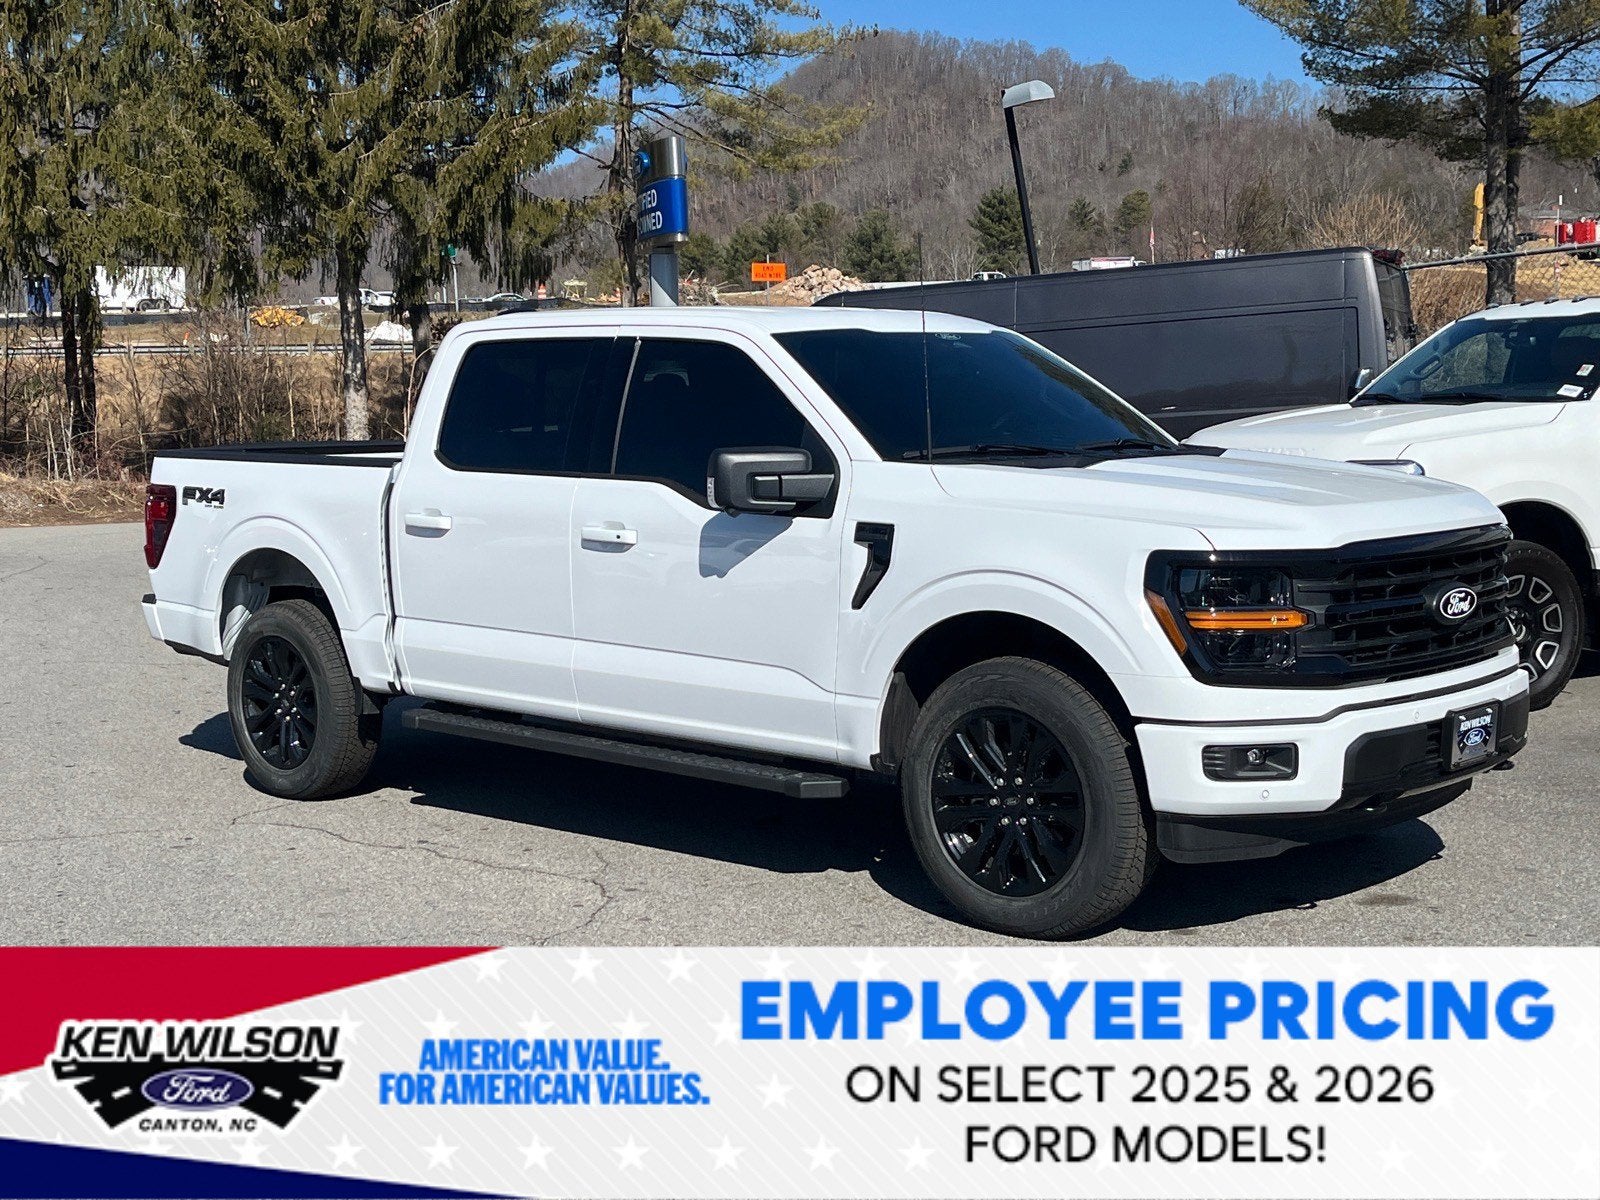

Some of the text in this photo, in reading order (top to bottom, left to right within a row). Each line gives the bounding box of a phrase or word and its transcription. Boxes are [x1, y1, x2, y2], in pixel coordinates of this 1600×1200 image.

[182, 486, 225, 506] FX4
[1447, 592, 1472, 615] Ford
[1467, 731, 1482, 745] Ford
